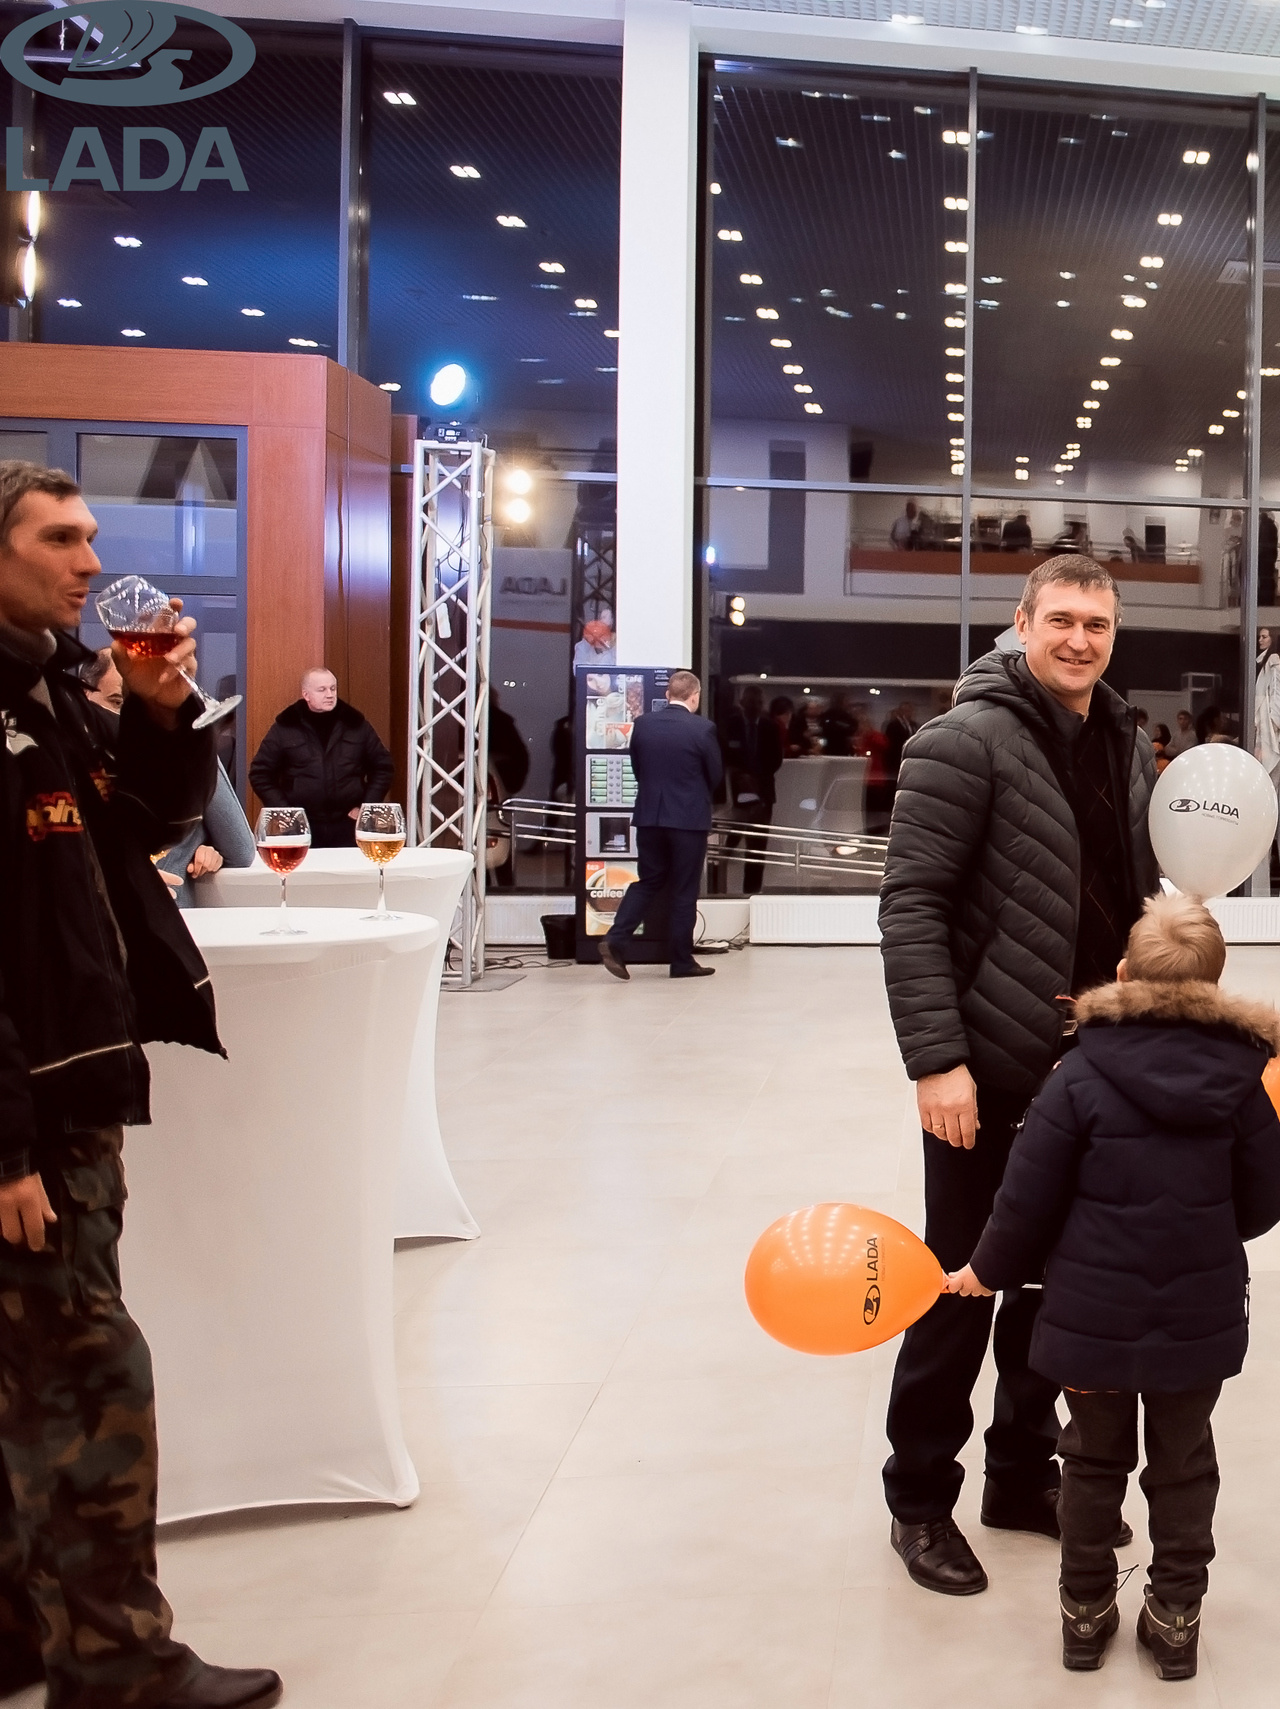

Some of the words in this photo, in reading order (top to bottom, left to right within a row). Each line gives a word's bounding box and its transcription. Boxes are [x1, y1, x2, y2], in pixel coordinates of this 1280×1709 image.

[1203, 800, 1239, 819] LADA
[590, 889, 624, 898] coffee
[866, 1237, 879, 1281] LADA
